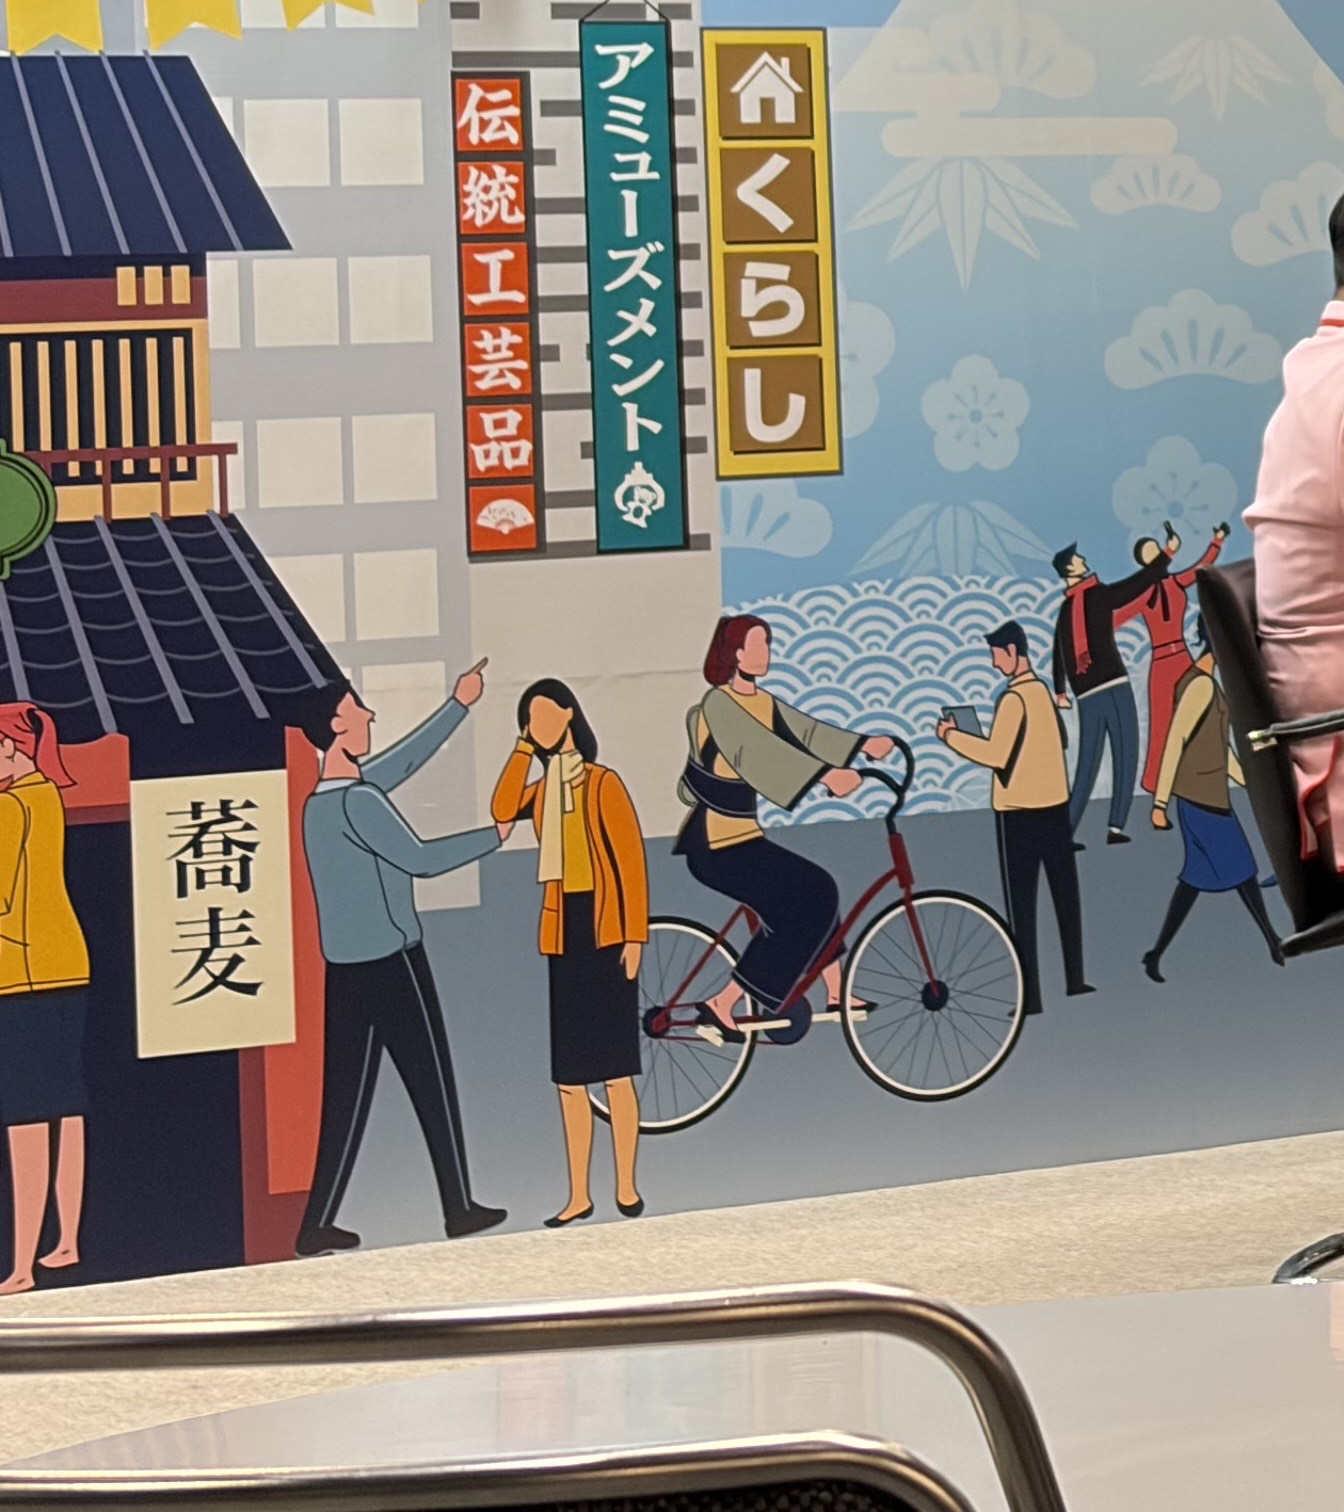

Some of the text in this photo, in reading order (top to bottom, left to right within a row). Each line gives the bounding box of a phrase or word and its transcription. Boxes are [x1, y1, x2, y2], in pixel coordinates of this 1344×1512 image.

[457, 83, 533, 471] 伝統工芸品
[594, 42, 665, 451] アミューズメント
[736, 152, 806, 442] くらし
[166, 799, 263, 1006] 蕎麦
